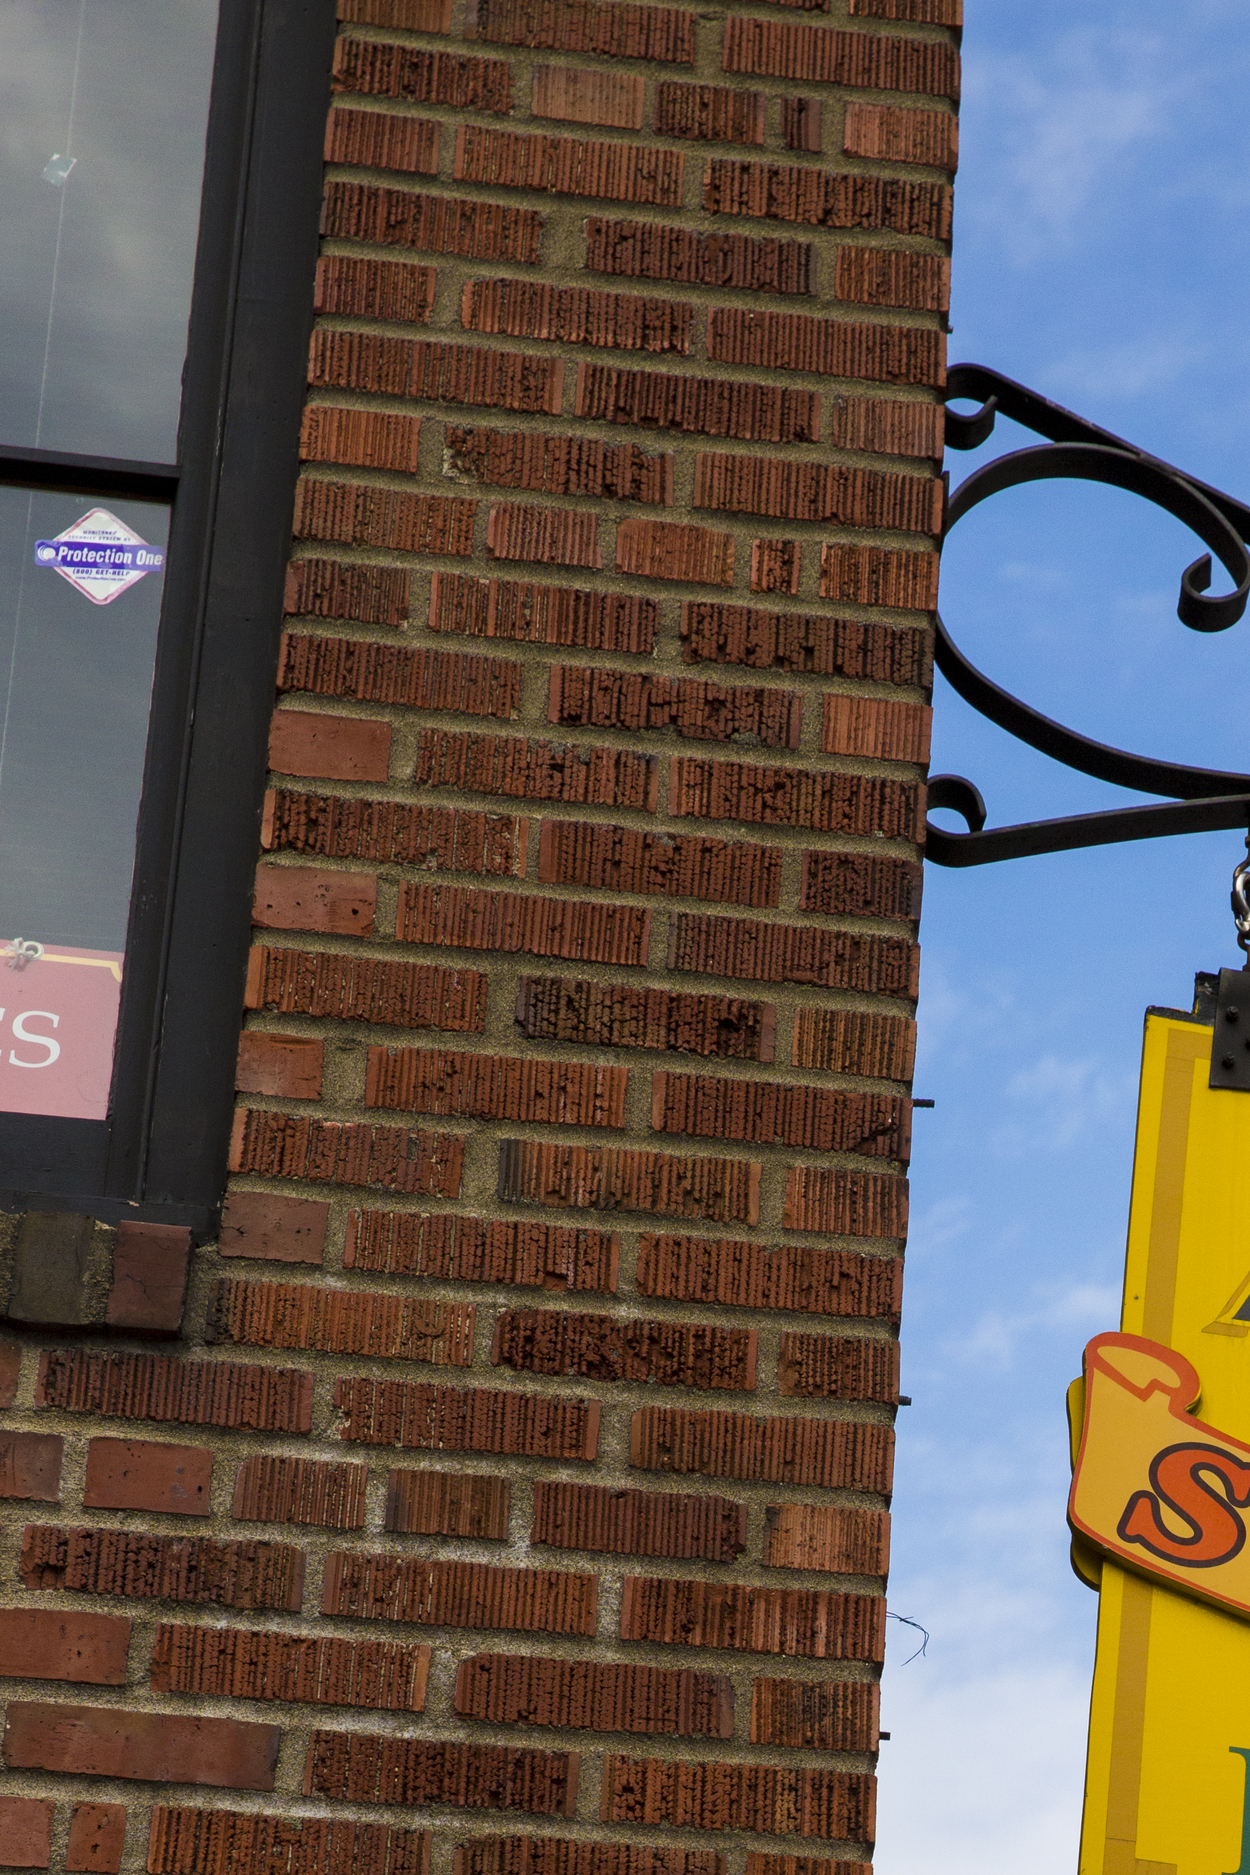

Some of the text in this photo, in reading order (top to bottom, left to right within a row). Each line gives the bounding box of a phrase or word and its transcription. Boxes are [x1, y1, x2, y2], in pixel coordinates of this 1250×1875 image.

[57, 546, 164, 566] Protection One
[0, 1007, 61, 1068] S
